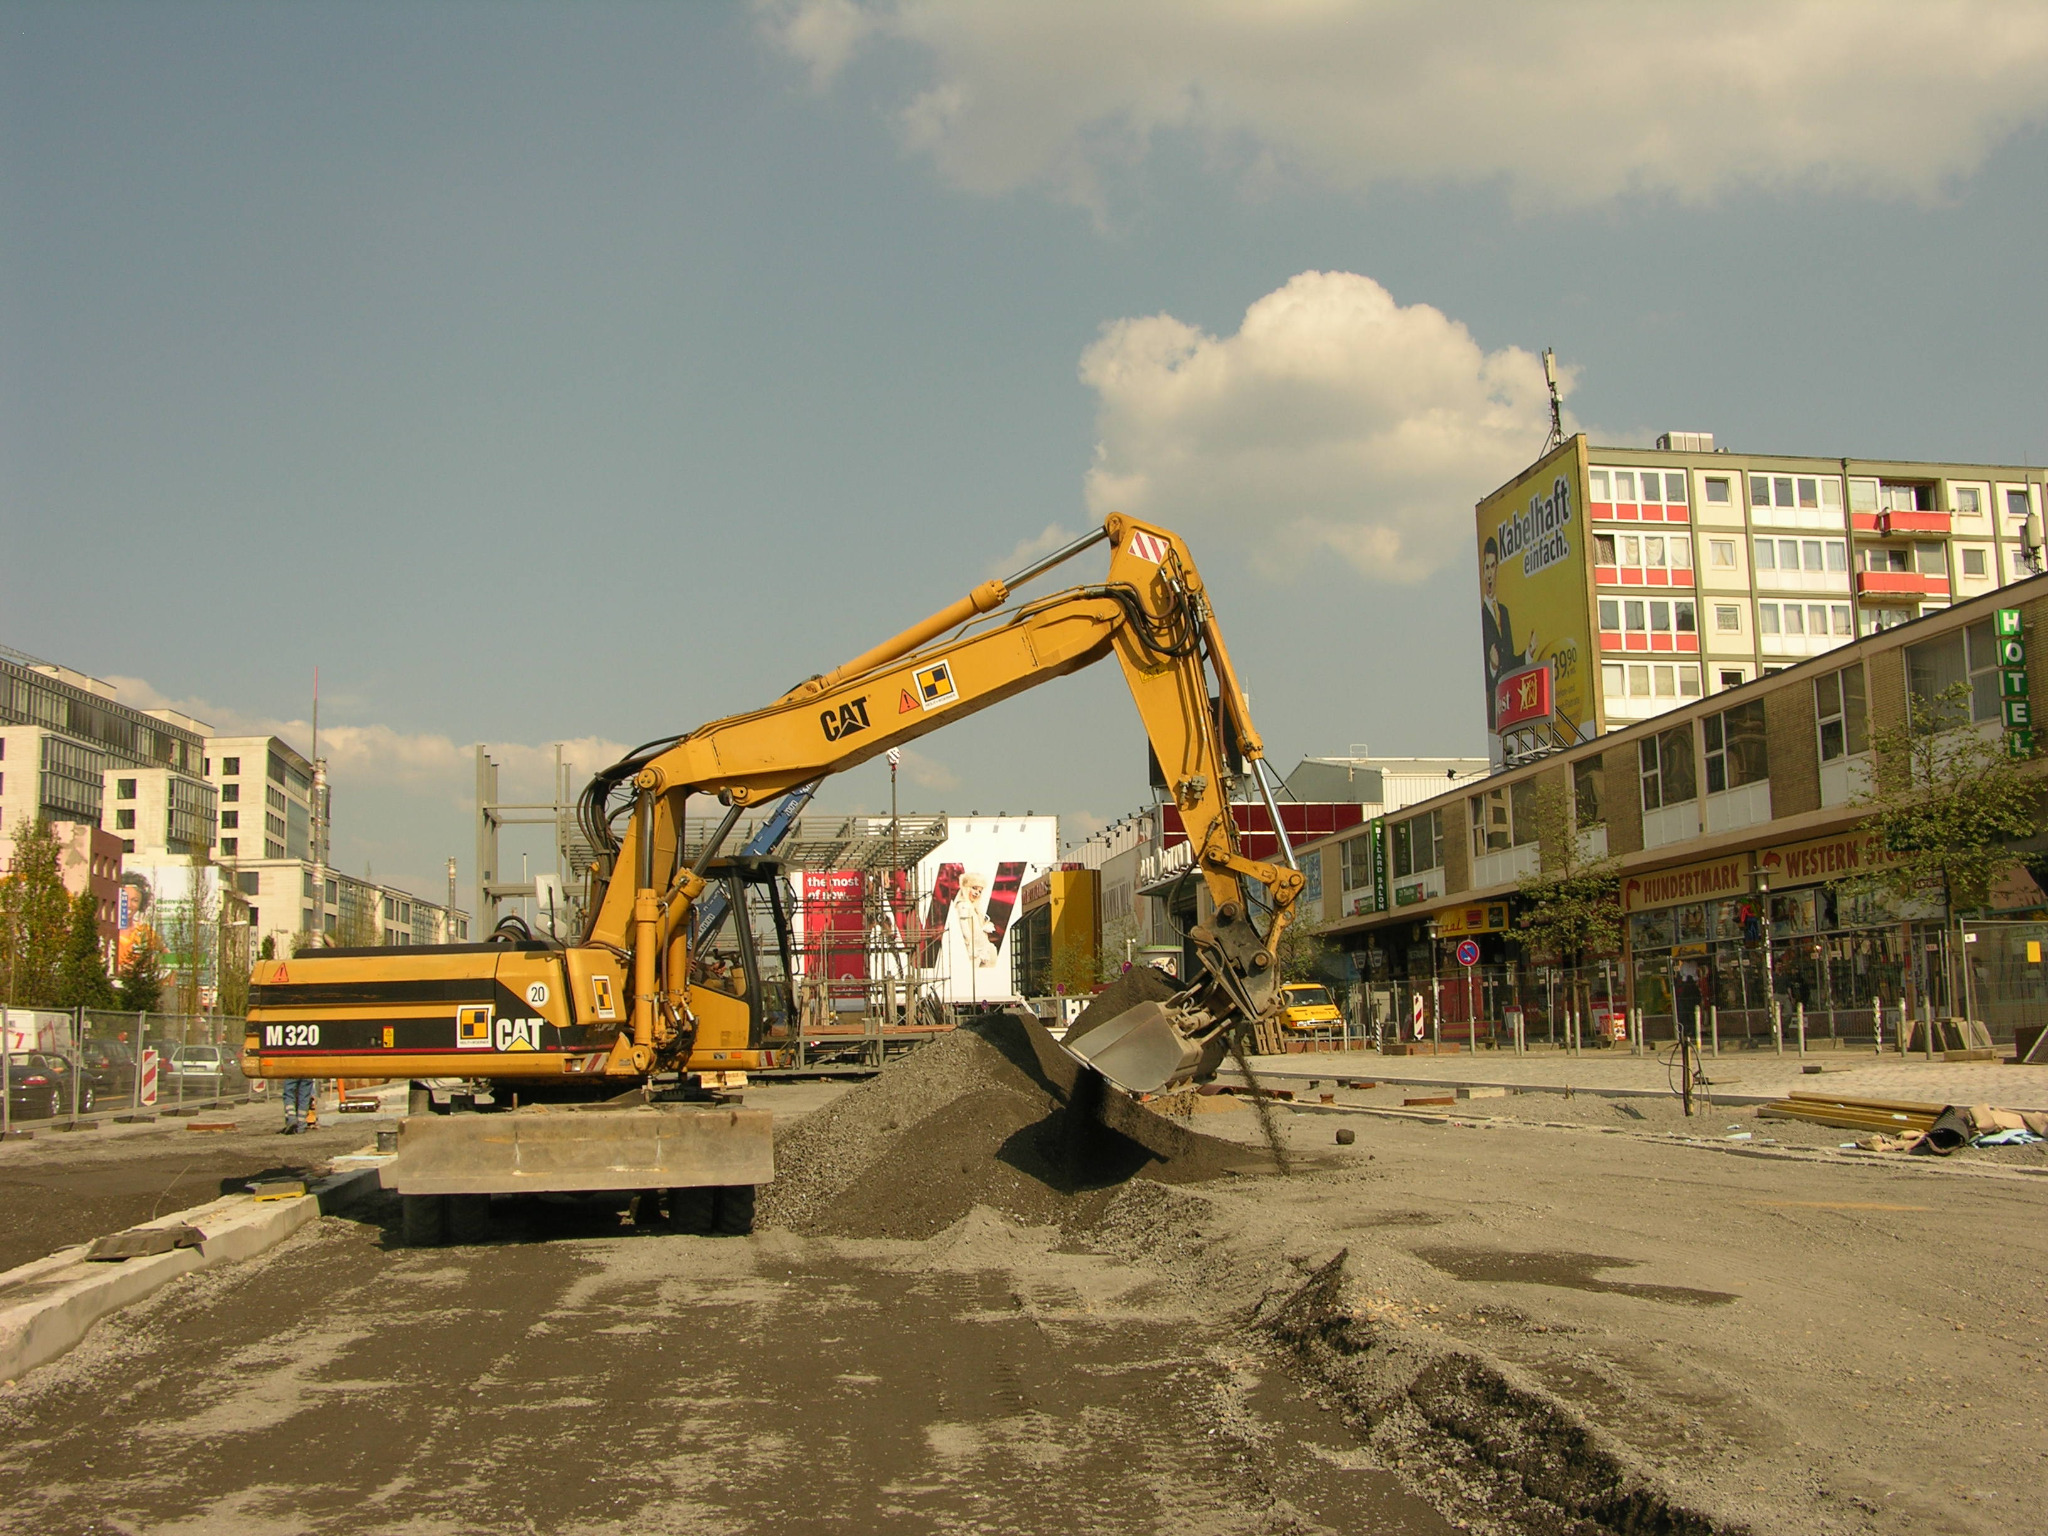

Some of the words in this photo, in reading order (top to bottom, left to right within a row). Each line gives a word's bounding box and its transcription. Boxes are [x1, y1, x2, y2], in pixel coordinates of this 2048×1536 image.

[1498, 479, 1569, 560] Kabelhaft
[1524, 528, 1568, 574] einfach.
[2002, 612, 2030, 753] HOTEL
[820, 696, 871, 742] CAT
[1375, 827, 1383, 873] BILLARD
[1786, 839, 1859, 879] WESTERN
[808, 877, 825, 887] the
[830, 877, 859, 887] most
[808, 890, 820, 900] of
[1377, 877, 1385, 910] SALON
[1644, 862, 1740, 904] HUNDERTMARK
[530, 986, 545, 1003] 20
[496, 1018, 544, 1051] CAT
